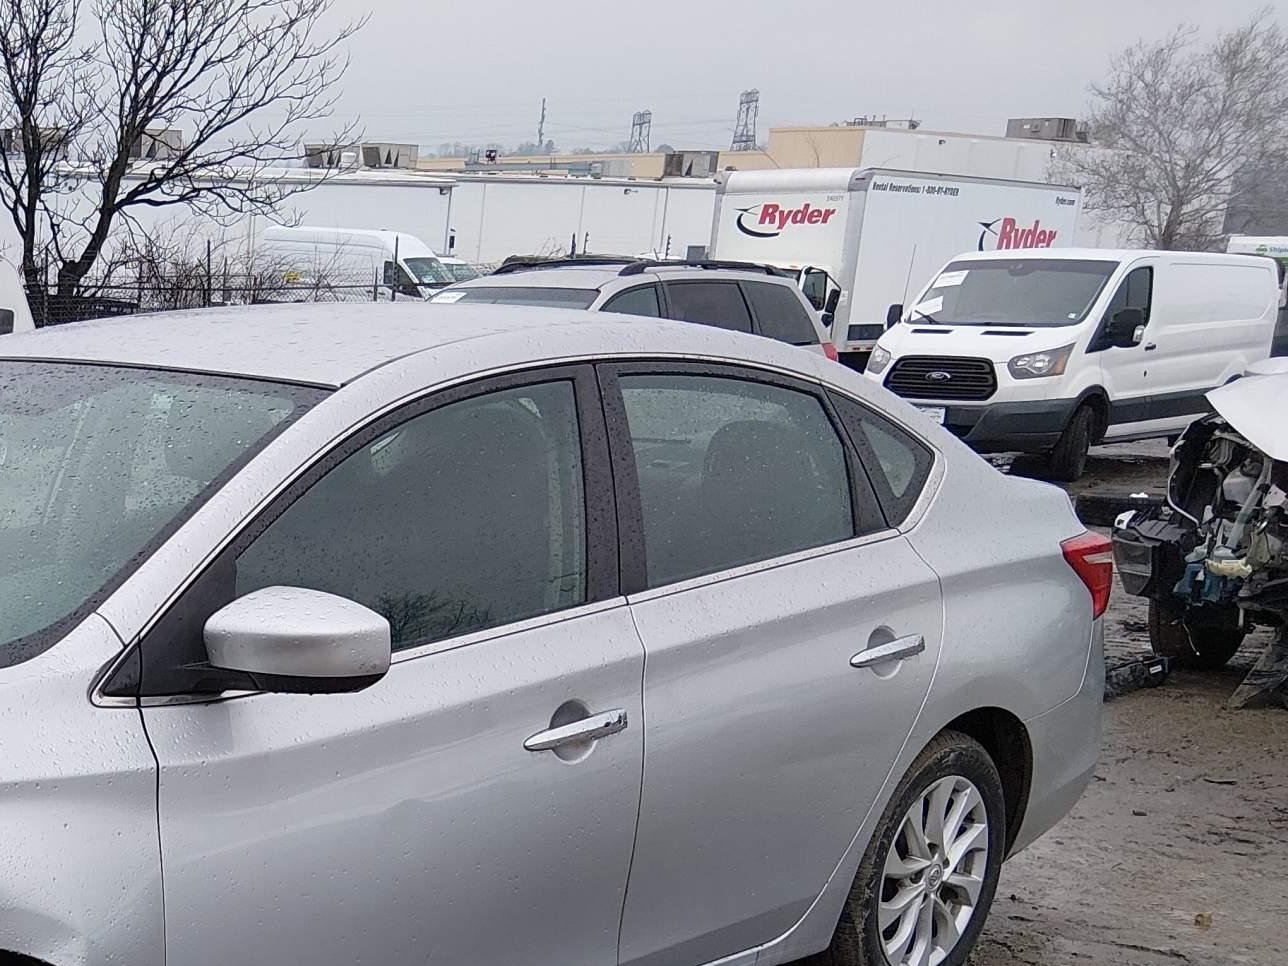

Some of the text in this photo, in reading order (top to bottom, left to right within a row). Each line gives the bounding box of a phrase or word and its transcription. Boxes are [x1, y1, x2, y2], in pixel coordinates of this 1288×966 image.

[872, 181, 888, 191] Rental
[758, 203, 836, 230] Ryder
[997, 217, 1057, 250] Ryder
